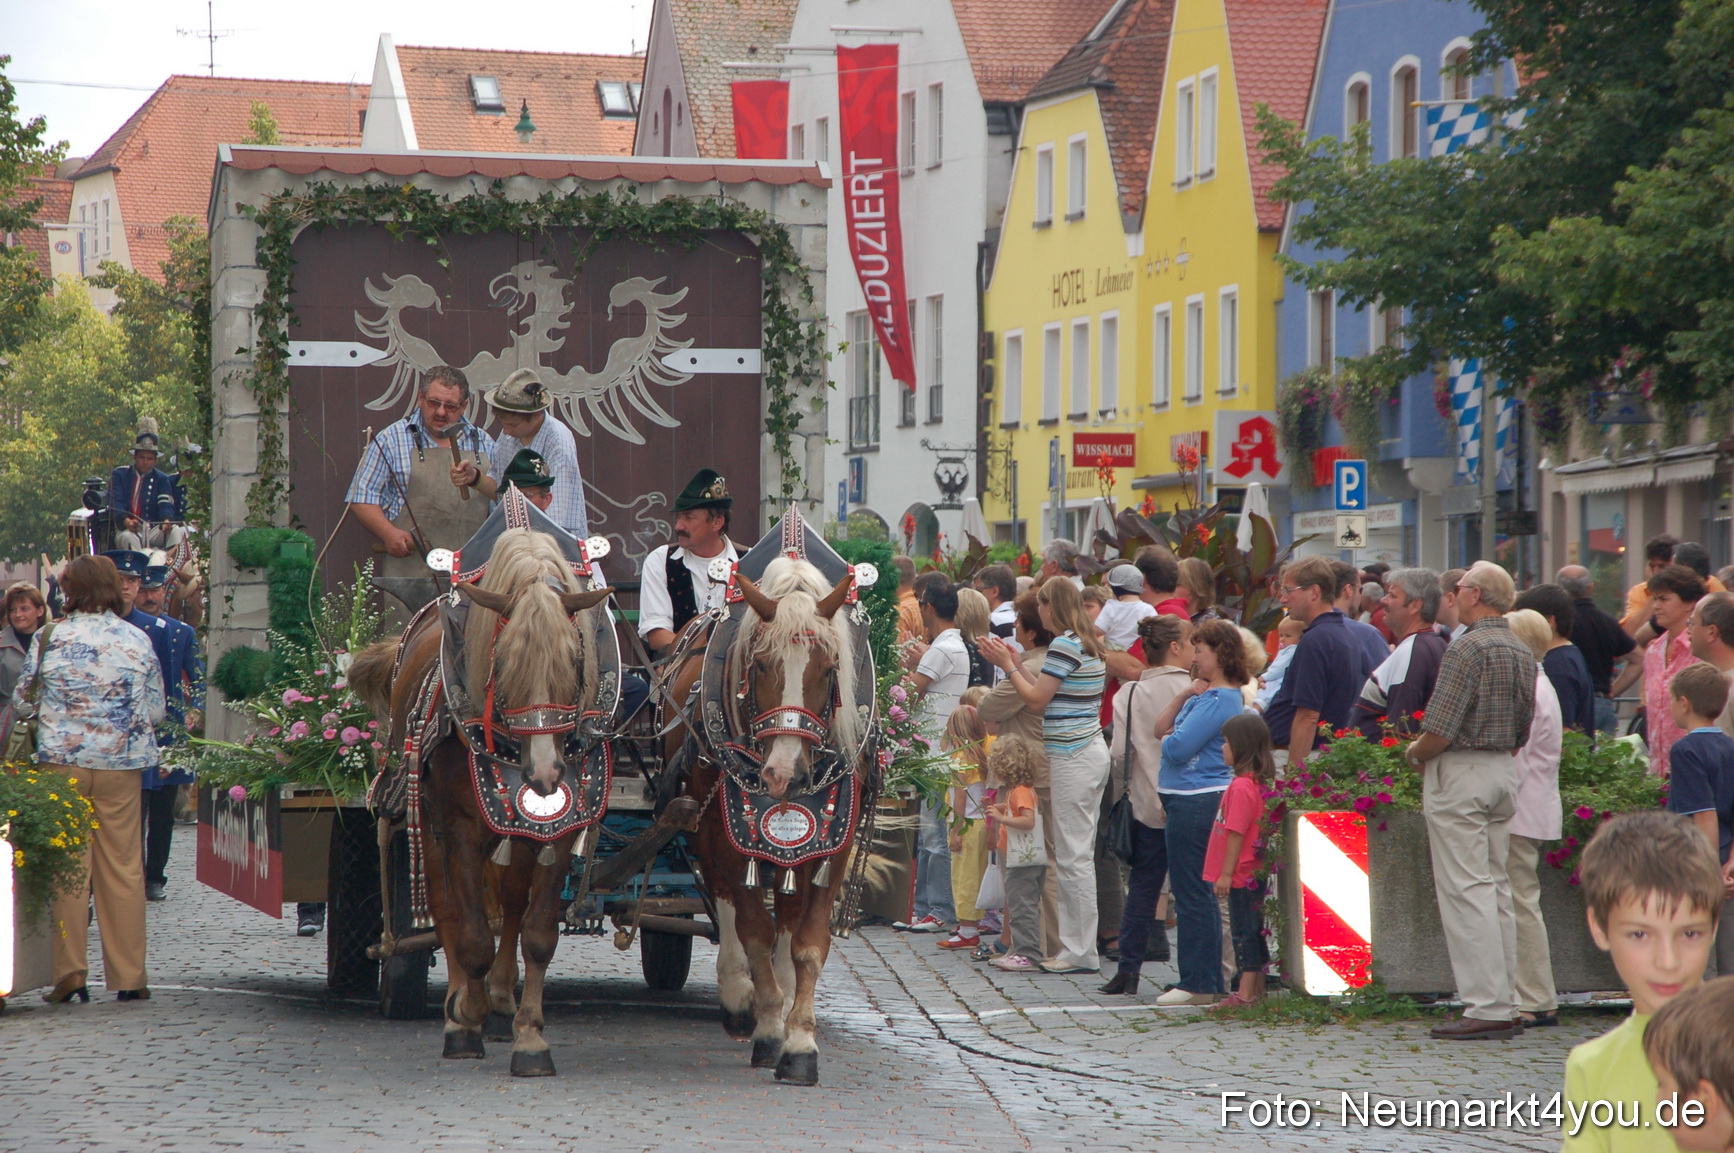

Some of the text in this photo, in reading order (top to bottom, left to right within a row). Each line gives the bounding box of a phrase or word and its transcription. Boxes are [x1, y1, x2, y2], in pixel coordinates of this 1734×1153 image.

[1053, 264, 1134, 308] HOTEL Lehmeier
[1076, 444, 1133, 456] WISSMACH
[1341, 466, 1360, 505] P
